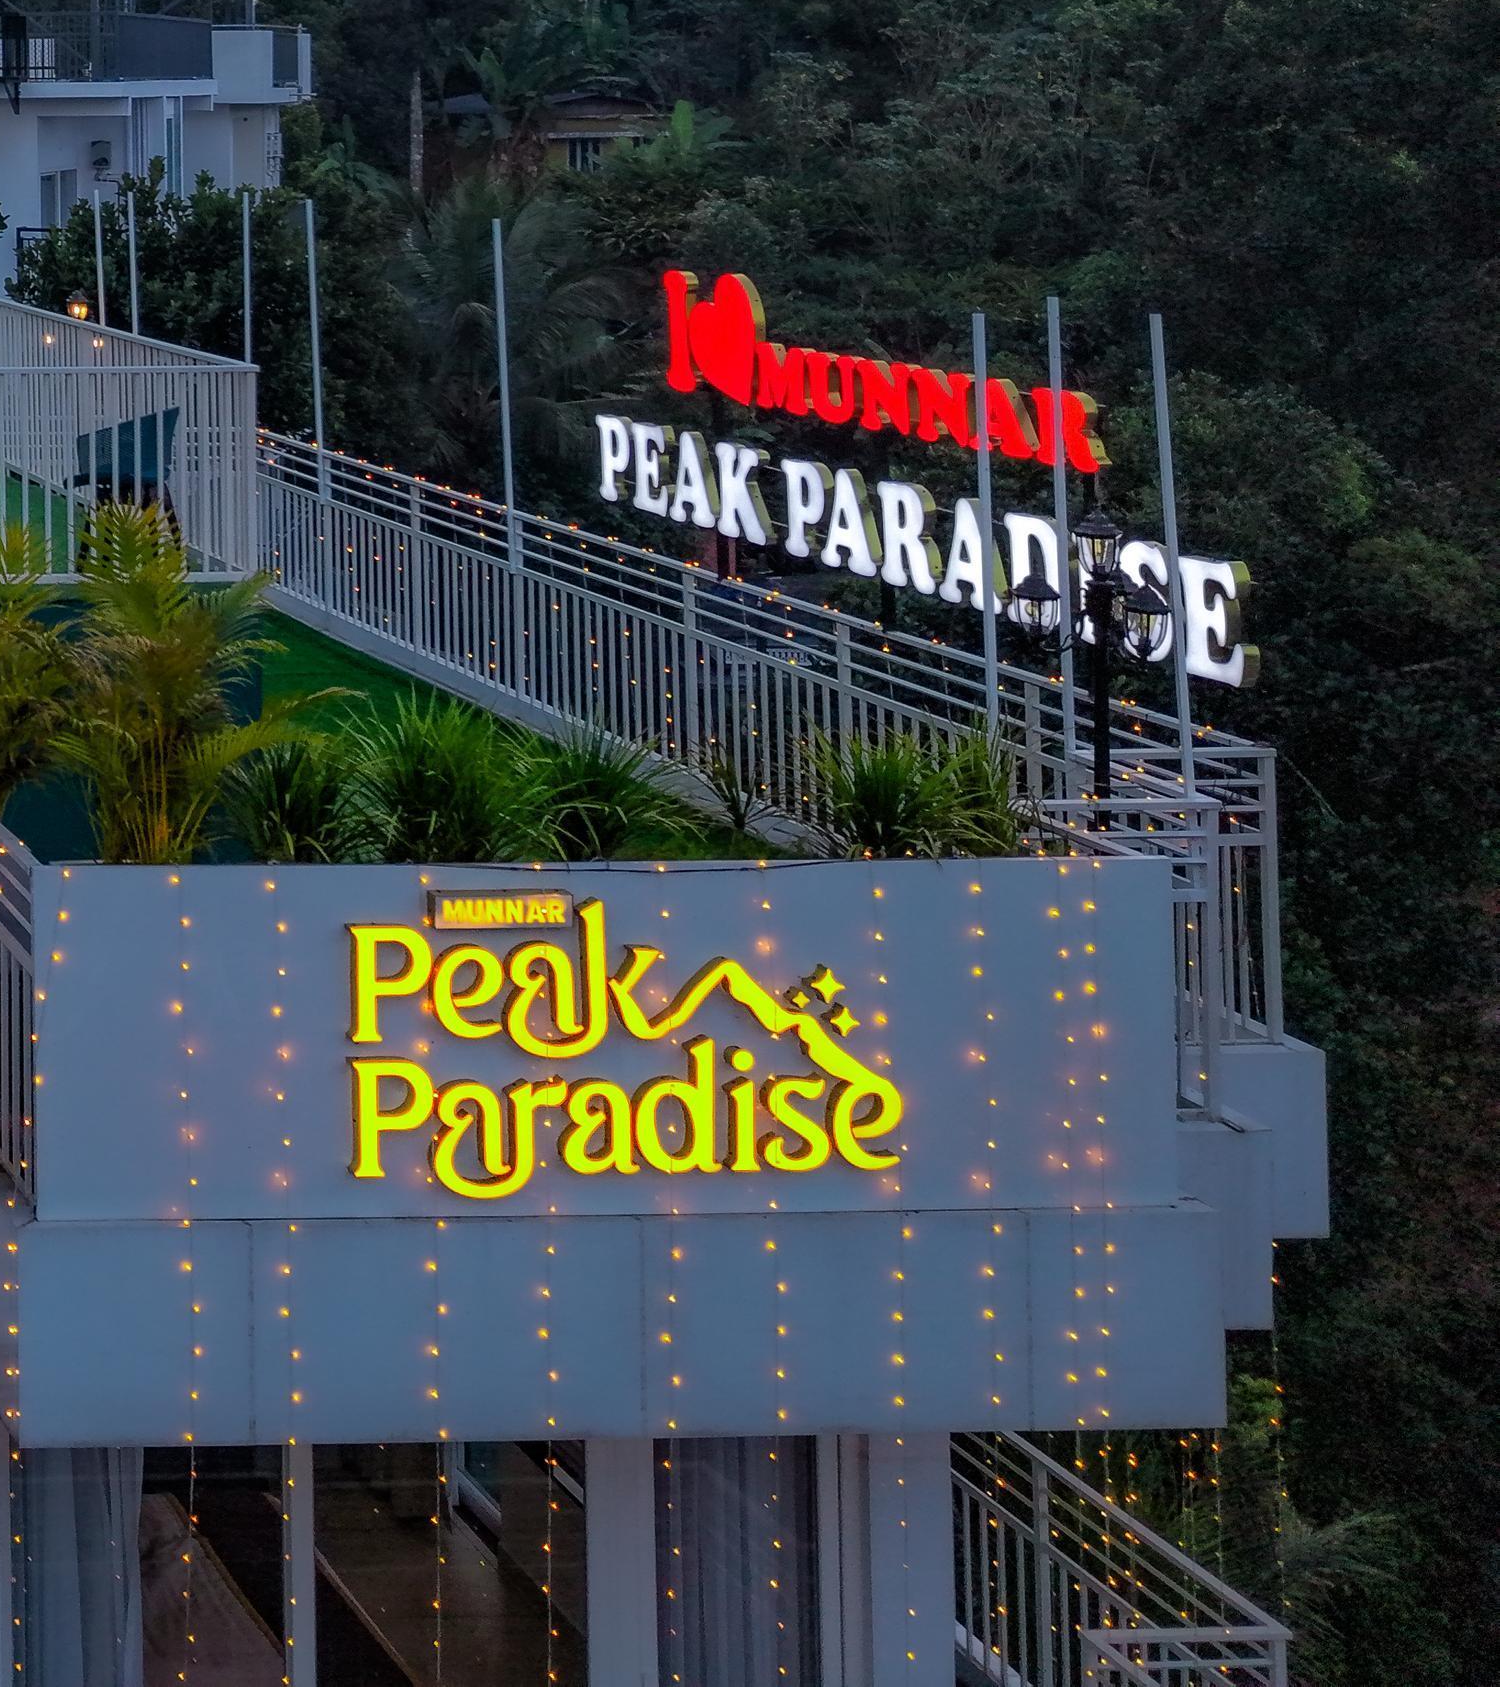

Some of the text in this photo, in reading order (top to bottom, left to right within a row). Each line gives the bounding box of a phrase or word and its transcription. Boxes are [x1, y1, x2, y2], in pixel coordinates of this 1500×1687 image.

[663, 269, 1102, 474] I MUNNAR
[596, 414, 768, 546] PEAK
[348, 898, 668, 1059] Peak
[442, 898, 565, 924] MUNNAR
[348, 1036, 904, 1199] Paradise
